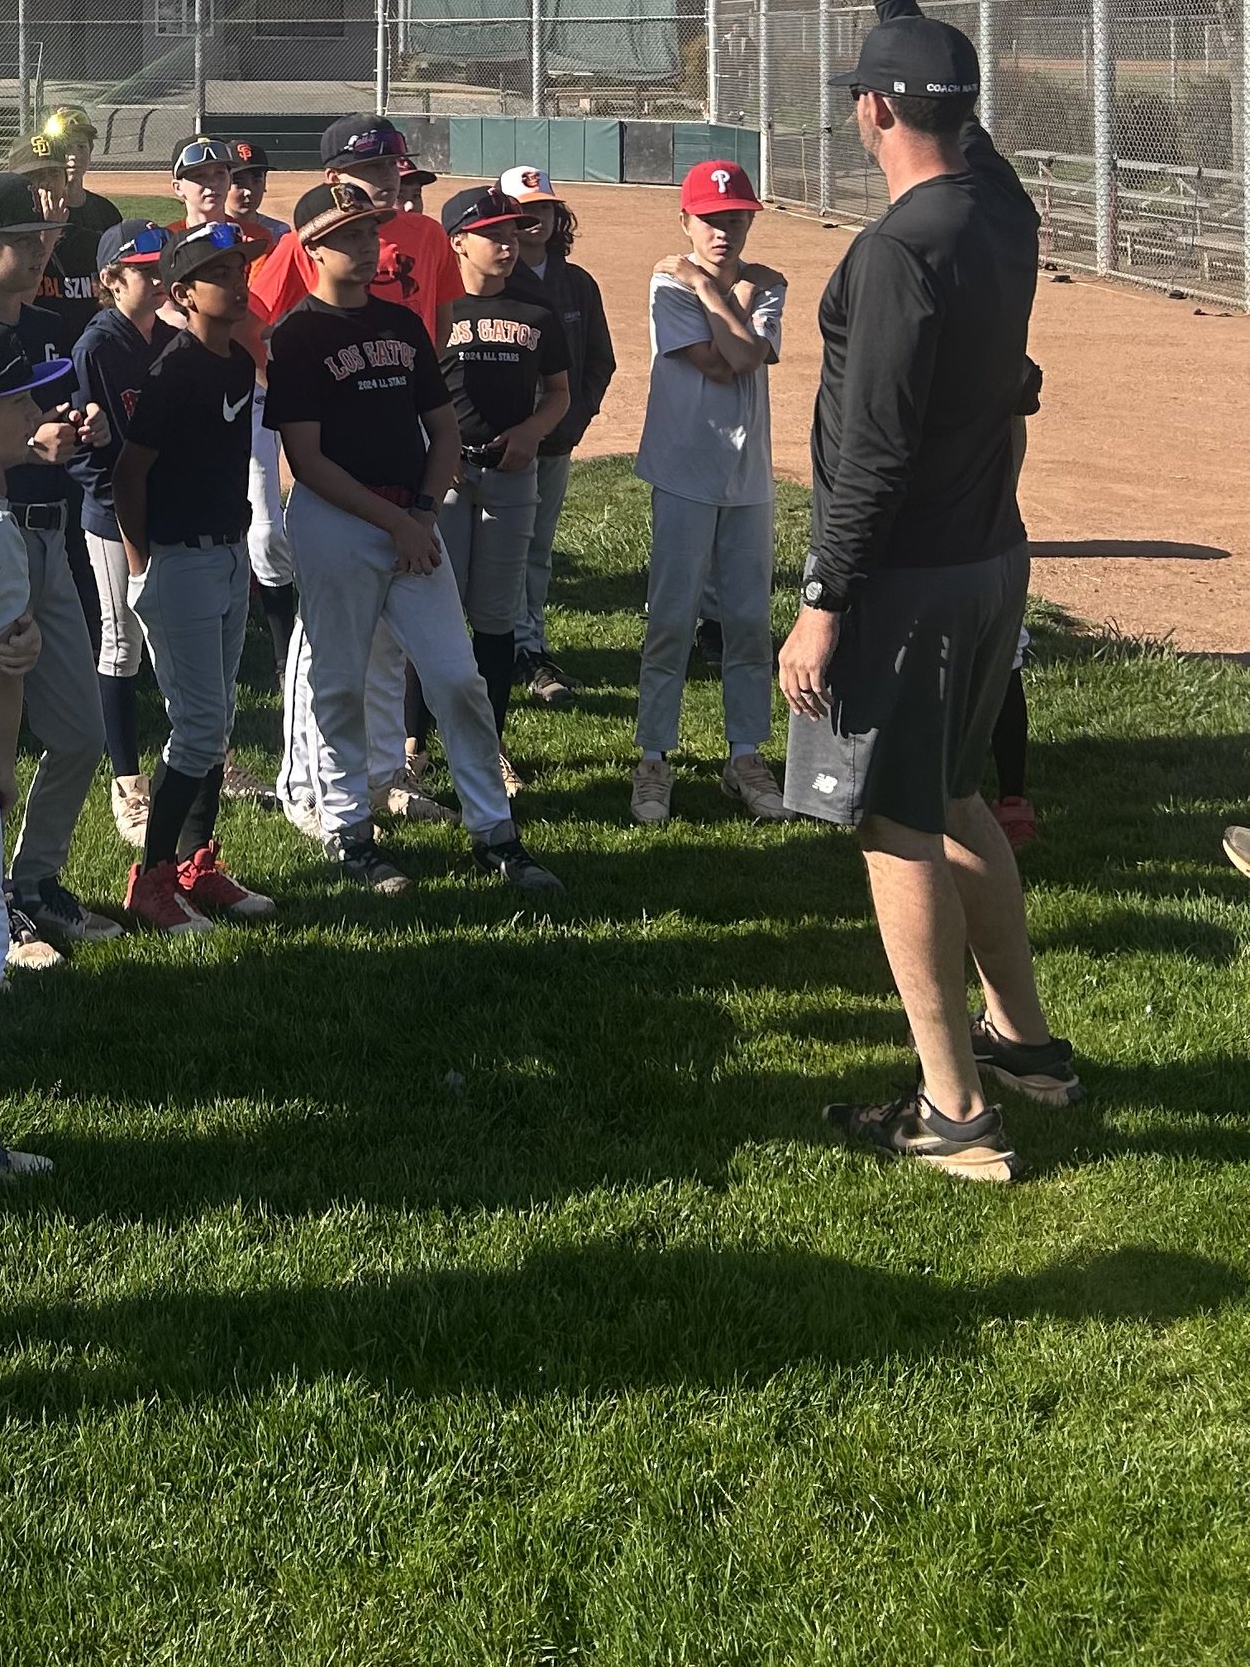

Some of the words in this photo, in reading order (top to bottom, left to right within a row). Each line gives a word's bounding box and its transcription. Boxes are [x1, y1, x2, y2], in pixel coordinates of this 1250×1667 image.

[926, 83, 961, 93] COACH
[710, 169, 730, 194] P
[64, 276, 92, 298] SZN
[447, 319, 473, 348] OS
[477, 318, 541, 351] GATOS
[324, 344, 365, 381] LOS
[458, 351, 481, 361] 2024
[483, 351, 497, 361] ALL
[498, 352, 519, 362] STARS
[357, 379, 378, 390] 2024
